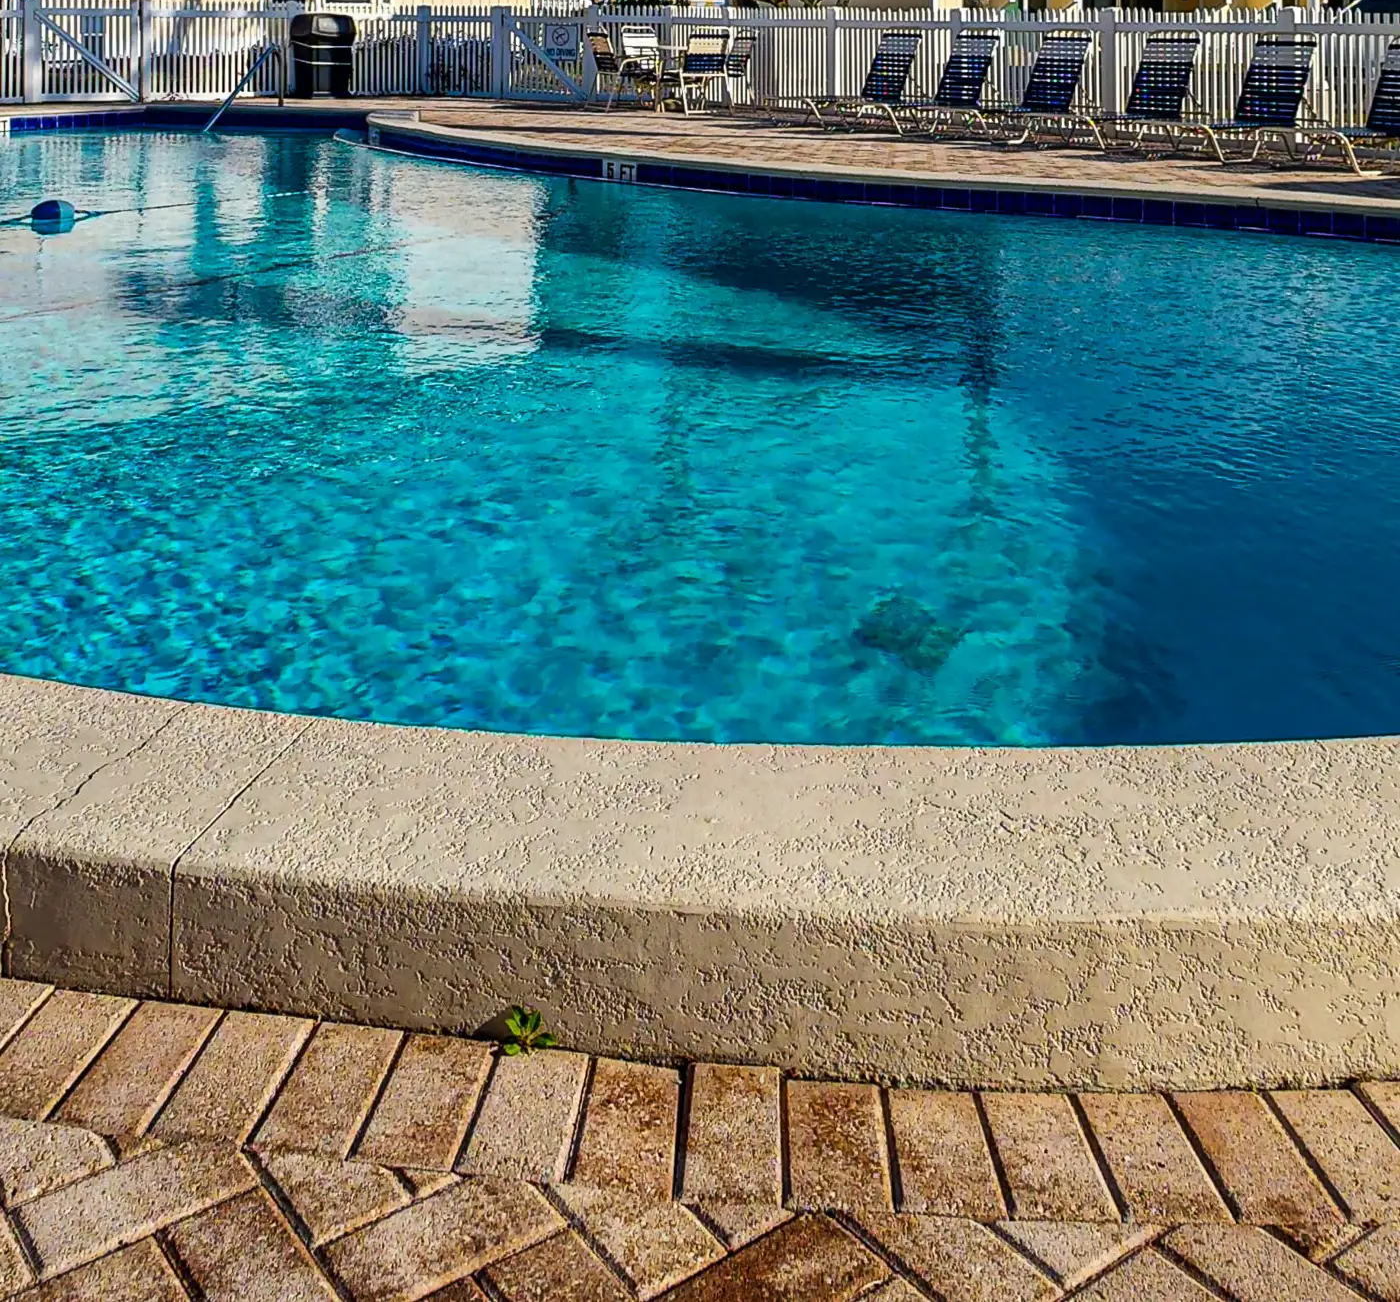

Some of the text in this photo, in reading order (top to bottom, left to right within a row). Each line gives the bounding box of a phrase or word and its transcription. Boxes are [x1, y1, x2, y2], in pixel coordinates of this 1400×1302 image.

[546, 48, 575, 57] NO DIVING
[620, 164, 635, 182] FT
